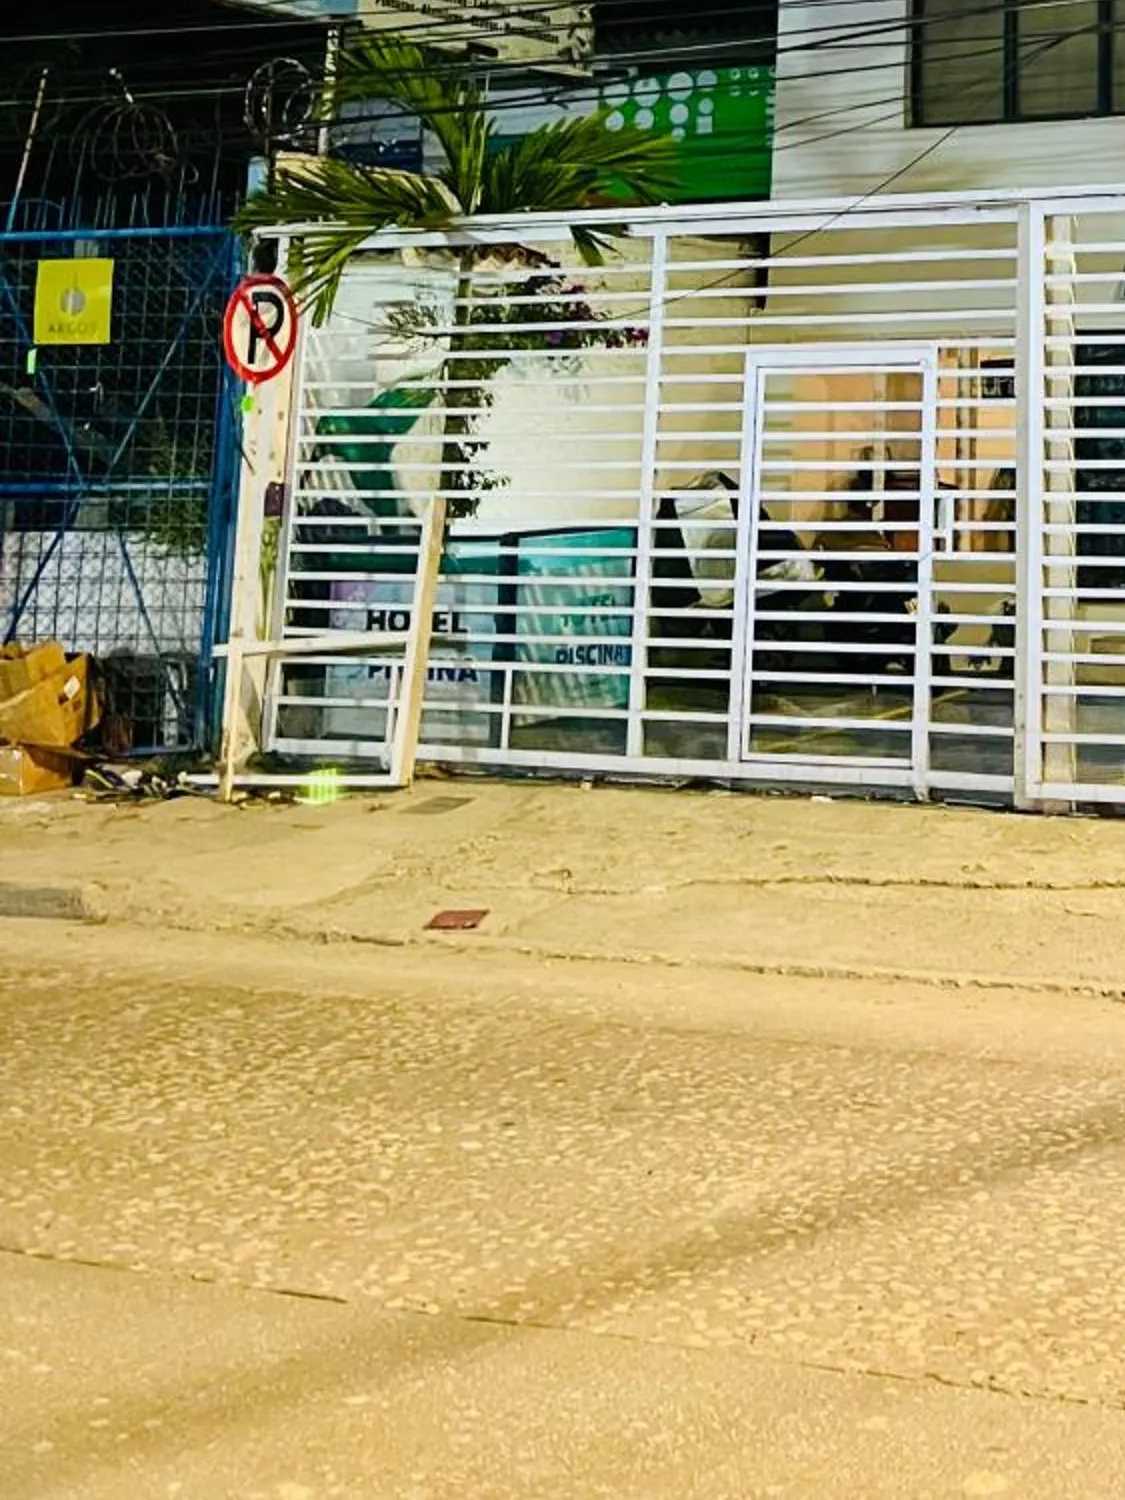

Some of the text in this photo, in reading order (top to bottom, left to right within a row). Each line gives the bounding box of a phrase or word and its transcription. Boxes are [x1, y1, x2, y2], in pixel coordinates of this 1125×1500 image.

[247, 291, 285, 364] P
[366, 608, 469, 633] HOEL
[366, 654, 479, 682] PIINA
